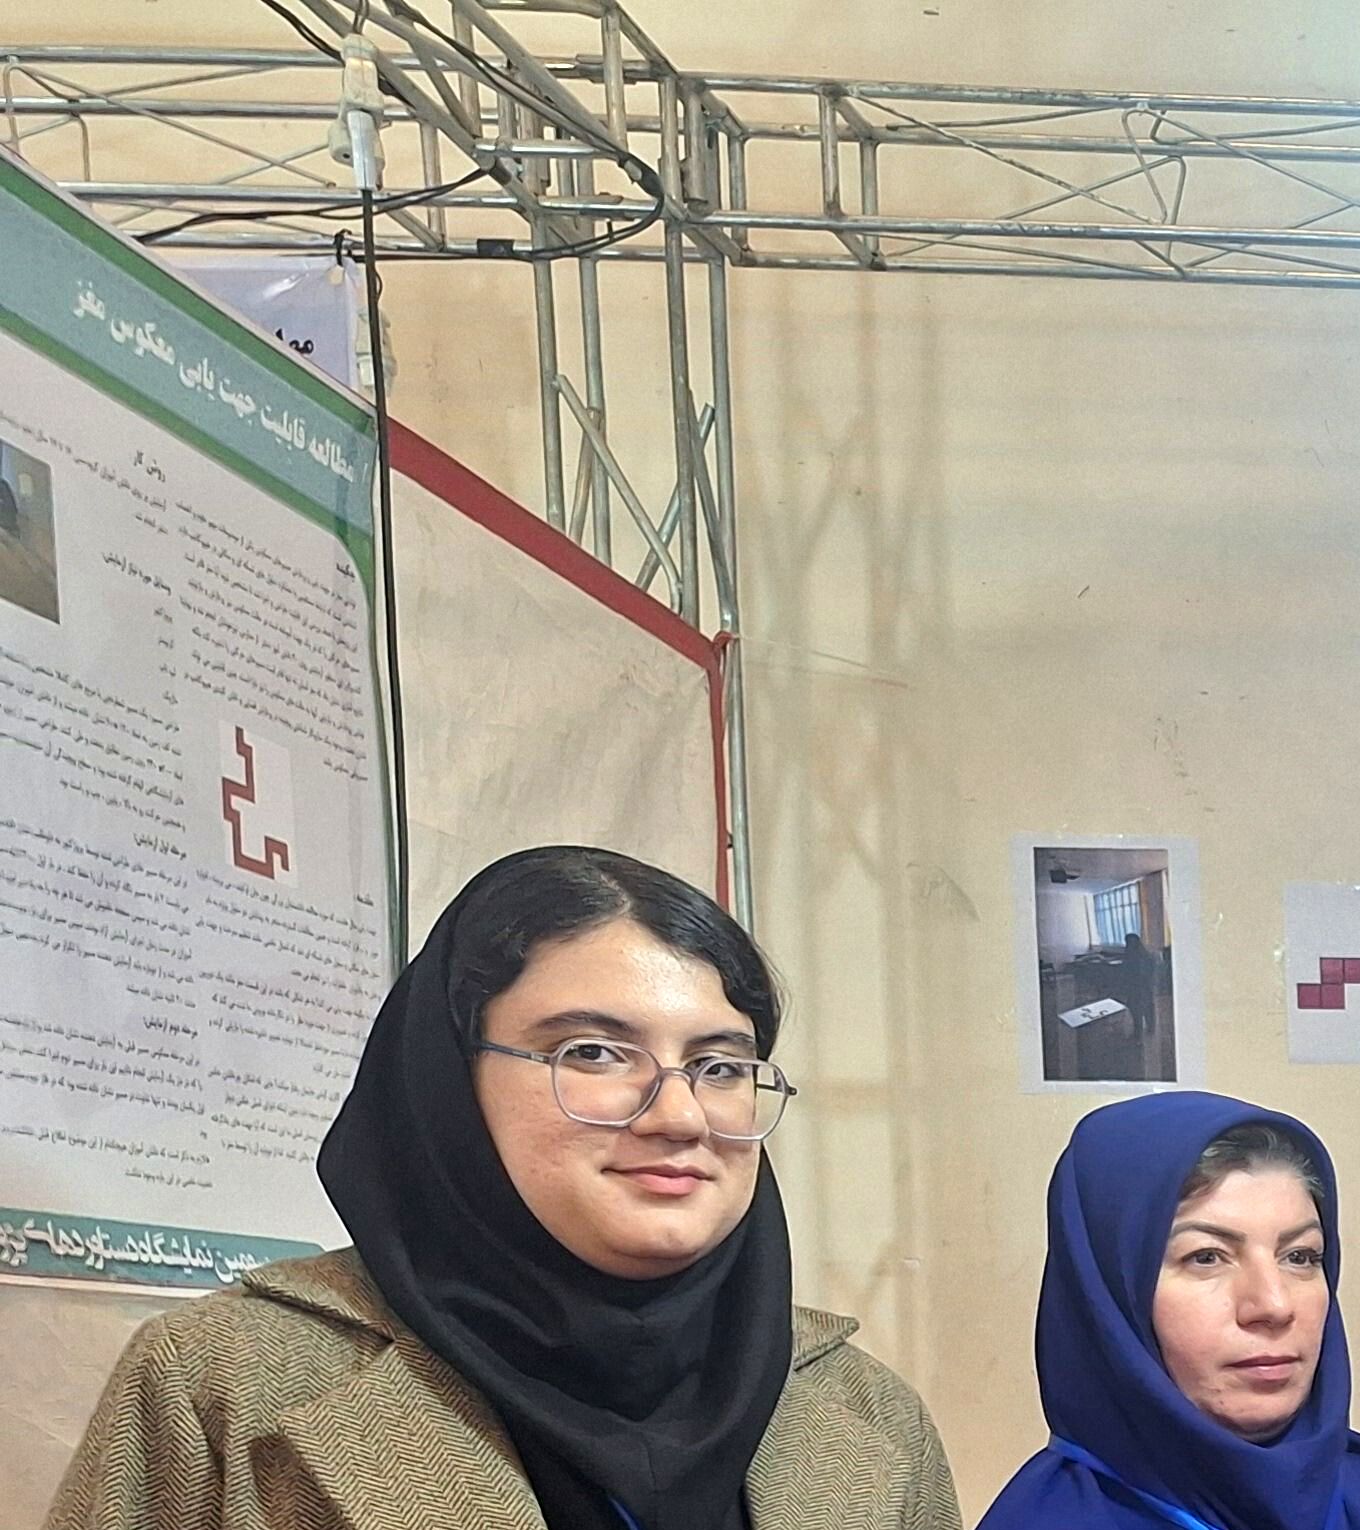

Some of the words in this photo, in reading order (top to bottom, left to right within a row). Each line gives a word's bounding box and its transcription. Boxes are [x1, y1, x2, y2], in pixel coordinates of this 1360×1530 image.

[73, 280, 106, 320] مغز
[111, 318, 176, 364] معکوس
[179, 358, 214, 398] یابی
[219, 379, 256, 424] جهت
[261, 405, 306, 450] قابلیت
[309, 437, 355, 483] مطالعه
